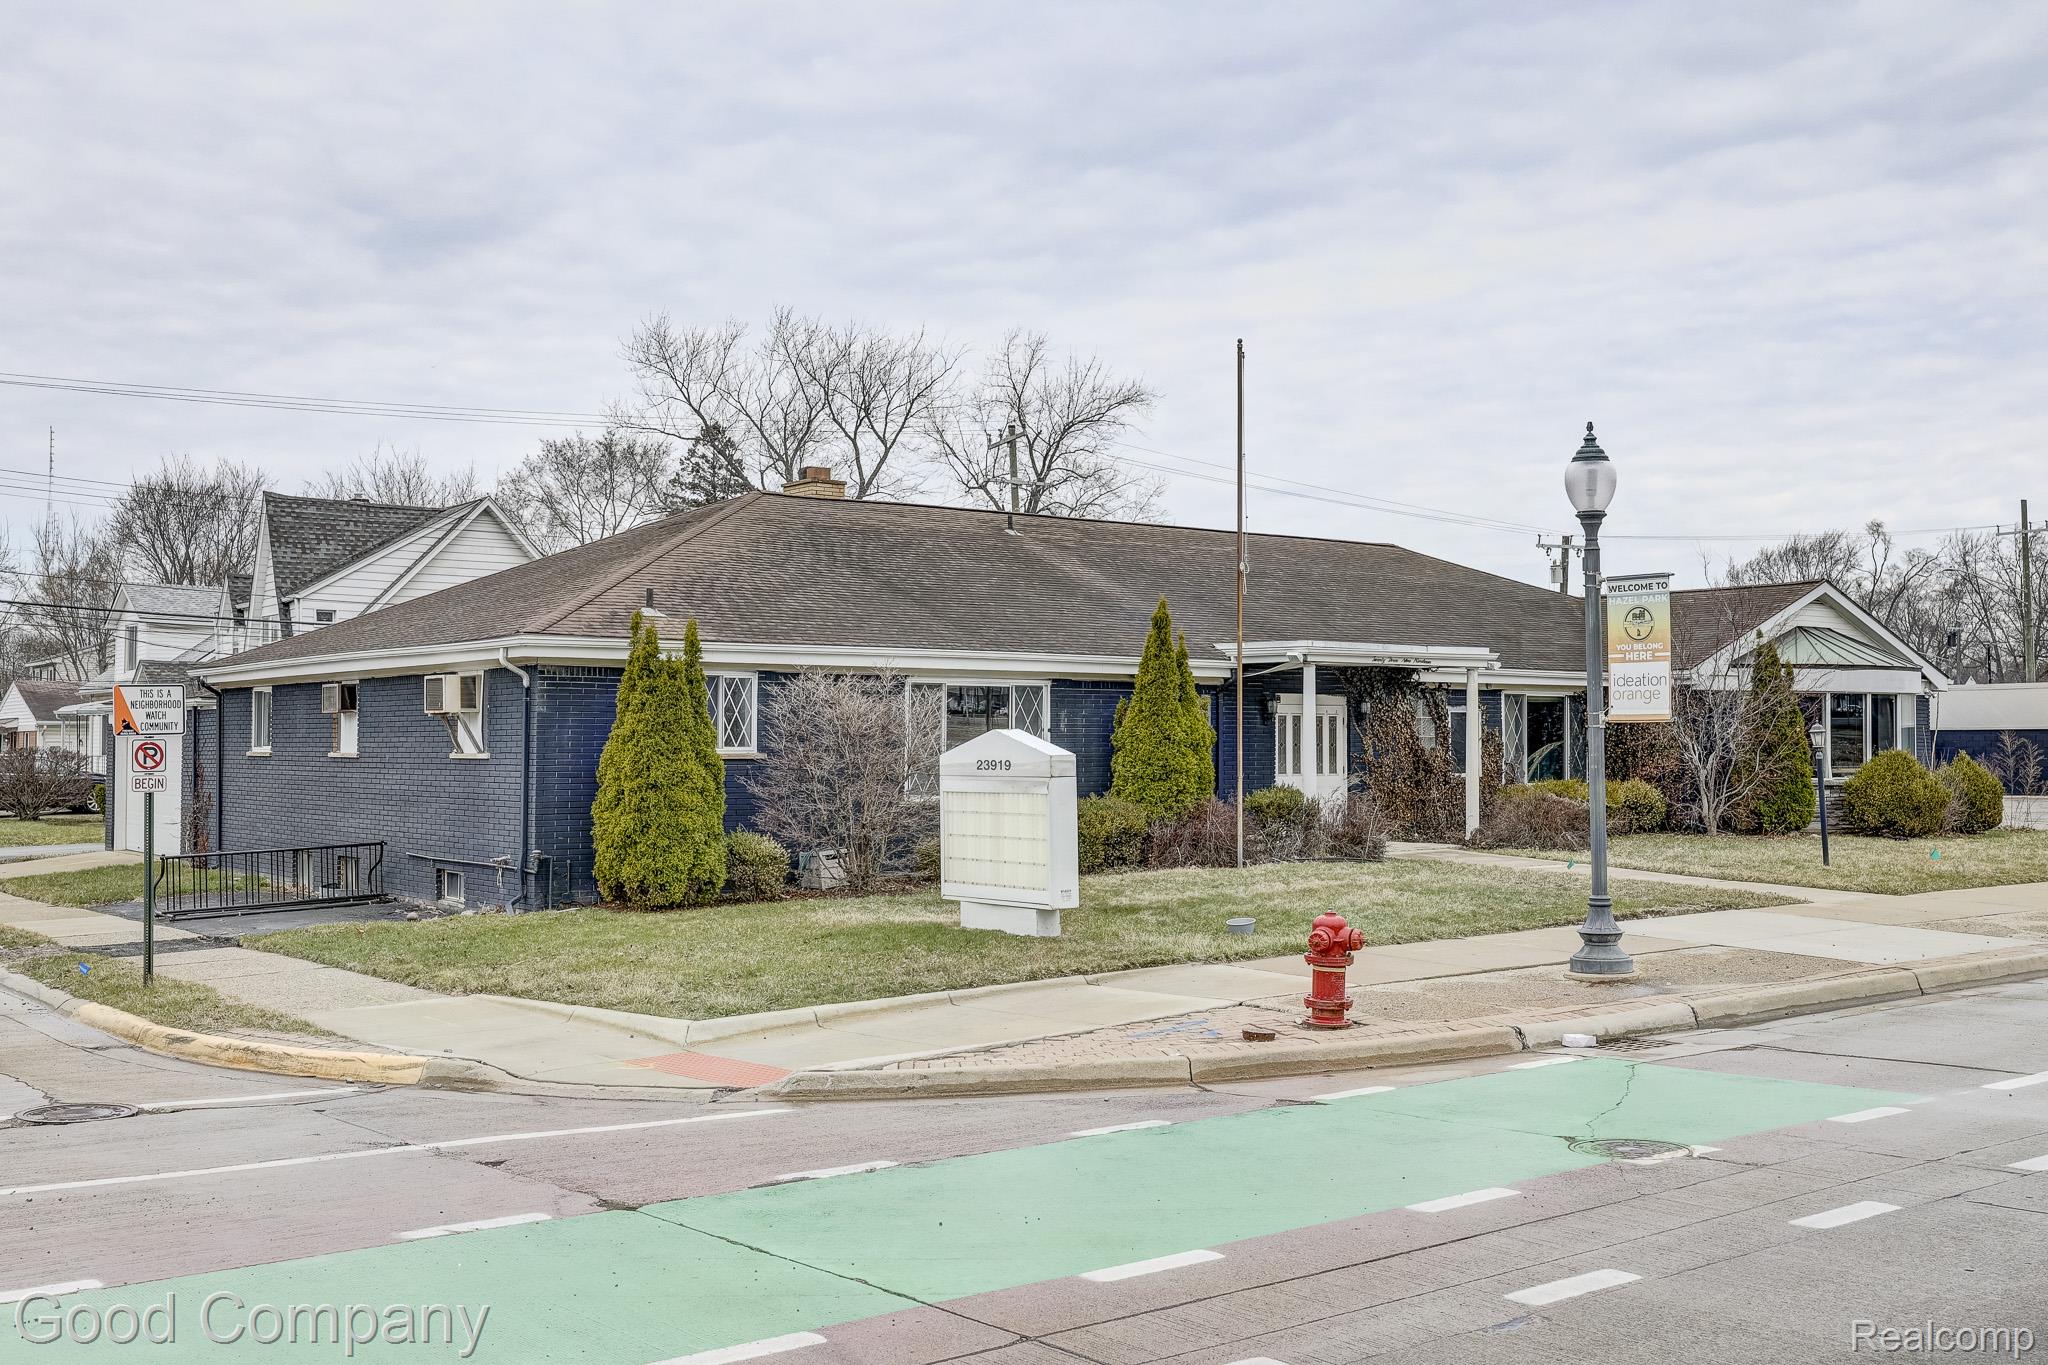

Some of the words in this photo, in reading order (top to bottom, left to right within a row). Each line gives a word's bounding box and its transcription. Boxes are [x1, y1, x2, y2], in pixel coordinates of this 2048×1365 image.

[1608, 582, 1654, 593] WELCOME
[1656, 581, 1668, 590] TO
[1609, 595, 1640, 606] HAZEL
[1642, 593, 1668, 604] PARK
[1616, 643, 1632, 651] YOU
[1633, 642, 1664, 651] BELONG
[1625, 651, 1653, 661] HERE
[1613, 672, 1667, 687] ideation
[140, 689, 154, 698] THIS
[157, 689, 164, 698] IS
[167, 689, 172, 698] A
[1612, 689, 1661, 704] orange
[130, 700, 182, 709] NEIGHBORHOOD
[146, 711, 167, 720] WATCH
[140, 722, 179, 731] COMMUNITY
[976, 759, 1012, 771] 23919
[134, 777, 164, 790] BEGIN
